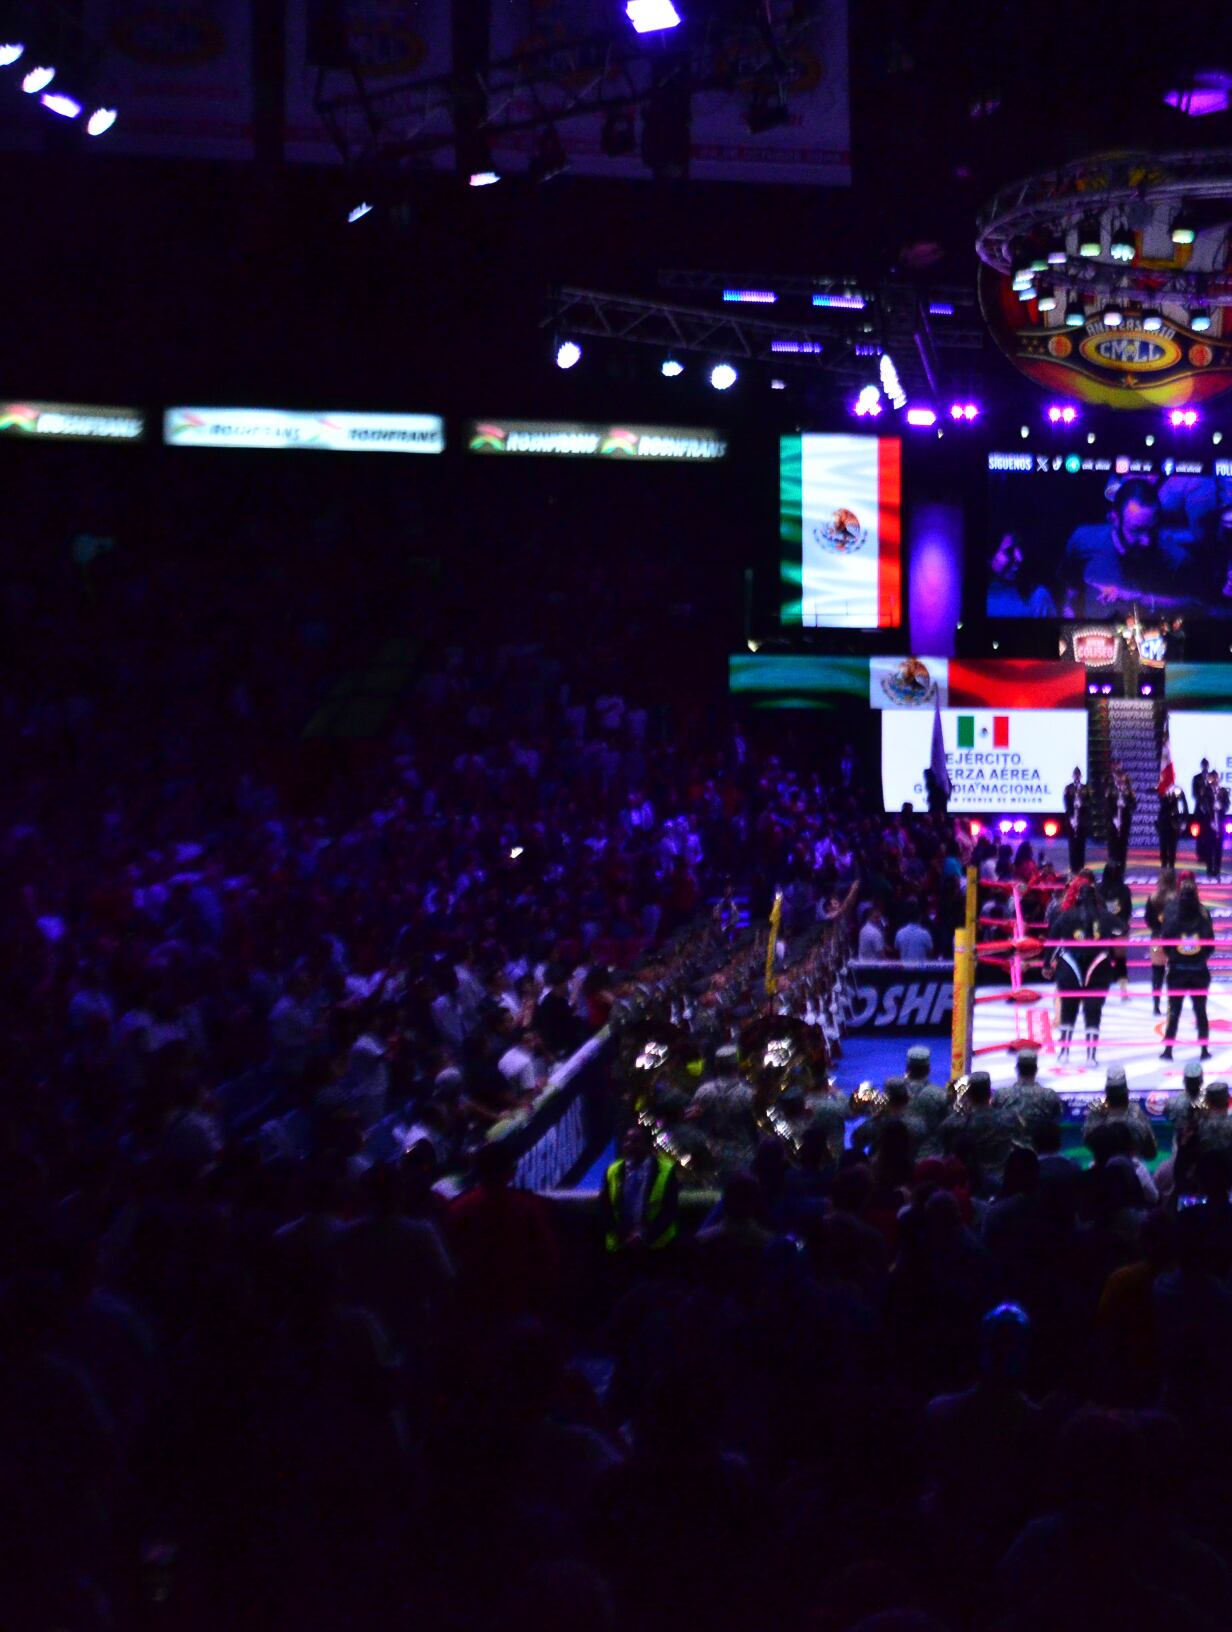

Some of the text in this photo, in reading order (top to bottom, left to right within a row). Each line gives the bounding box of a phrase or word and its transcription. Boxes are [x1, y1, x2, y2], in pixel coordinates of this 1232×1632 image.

[1099, 339, 1165, 363] CMLL
[989, 764, 1041, 781] AÉREA
[981, 783, 1052, 796] NACIONAL
